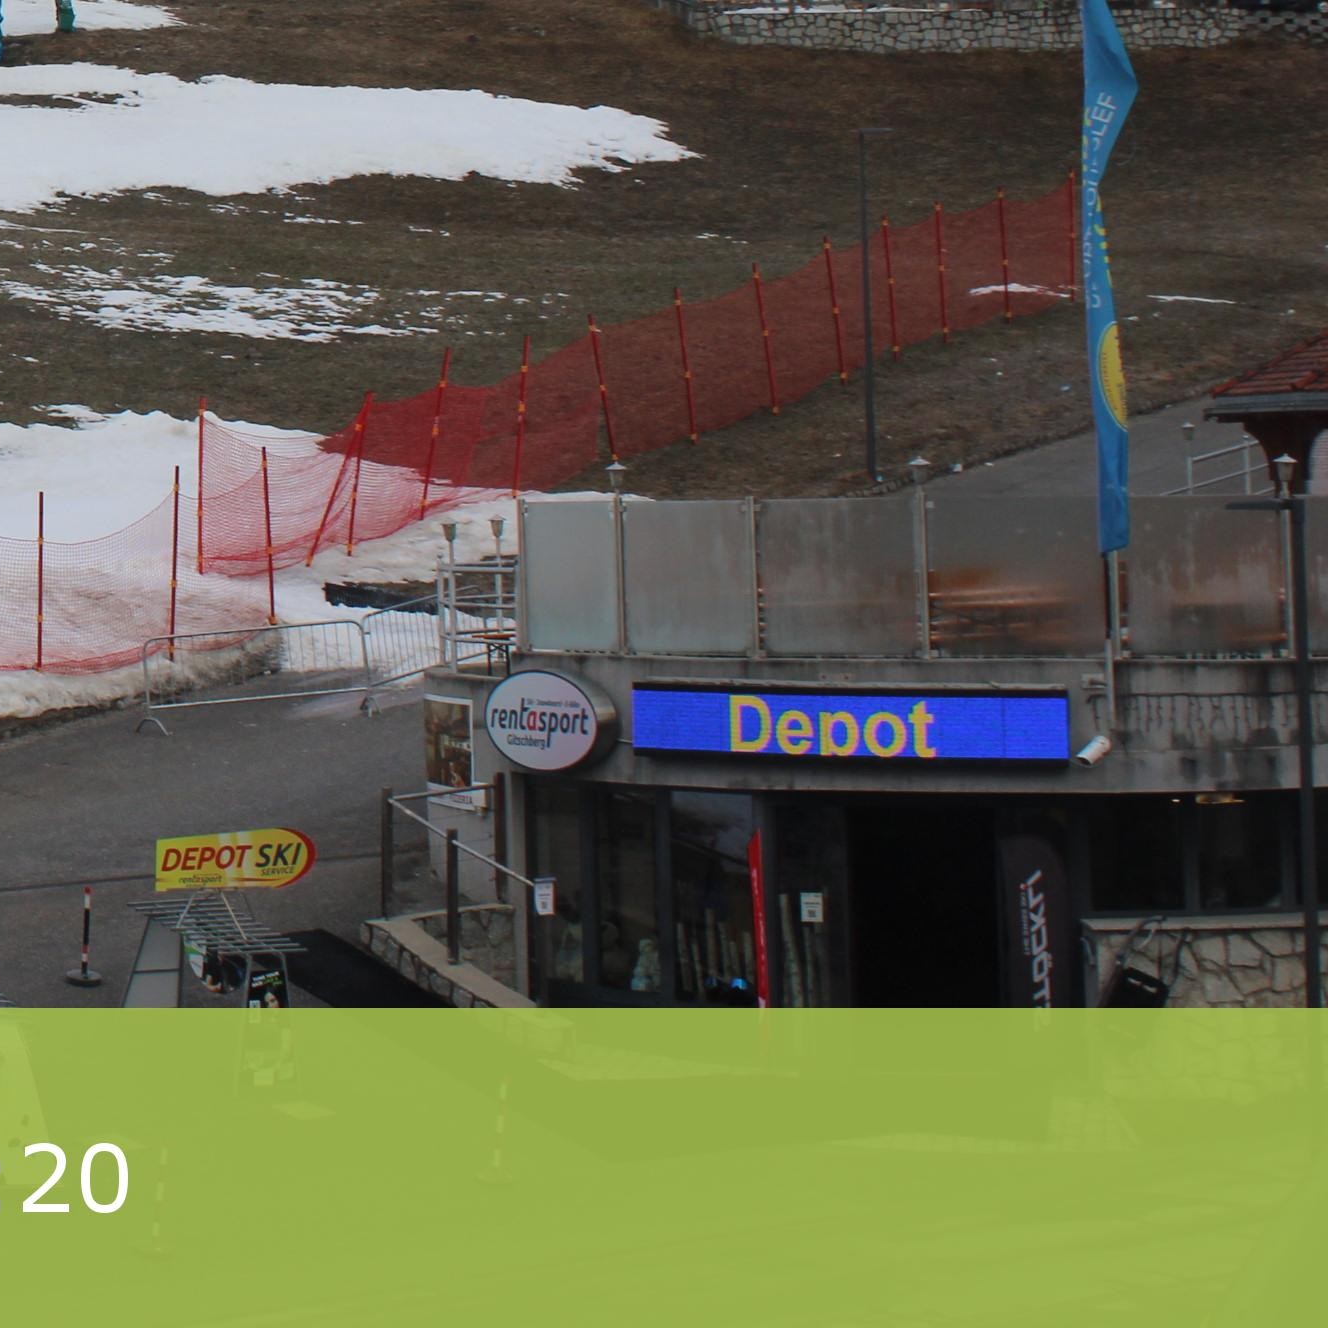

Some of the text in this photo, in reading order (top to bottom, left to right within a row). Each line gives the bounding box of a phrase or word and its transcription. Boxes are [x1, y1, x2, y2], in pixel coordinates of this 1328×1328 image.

[491, 698, 589, 747] rentasport
[729, 694, 936, 759] Depot
[506, 733, 545, 750] Gitschberg
[161, 842, 302, 872] DEPOT SKI
[260, 866, 294, 877] SERVICE
